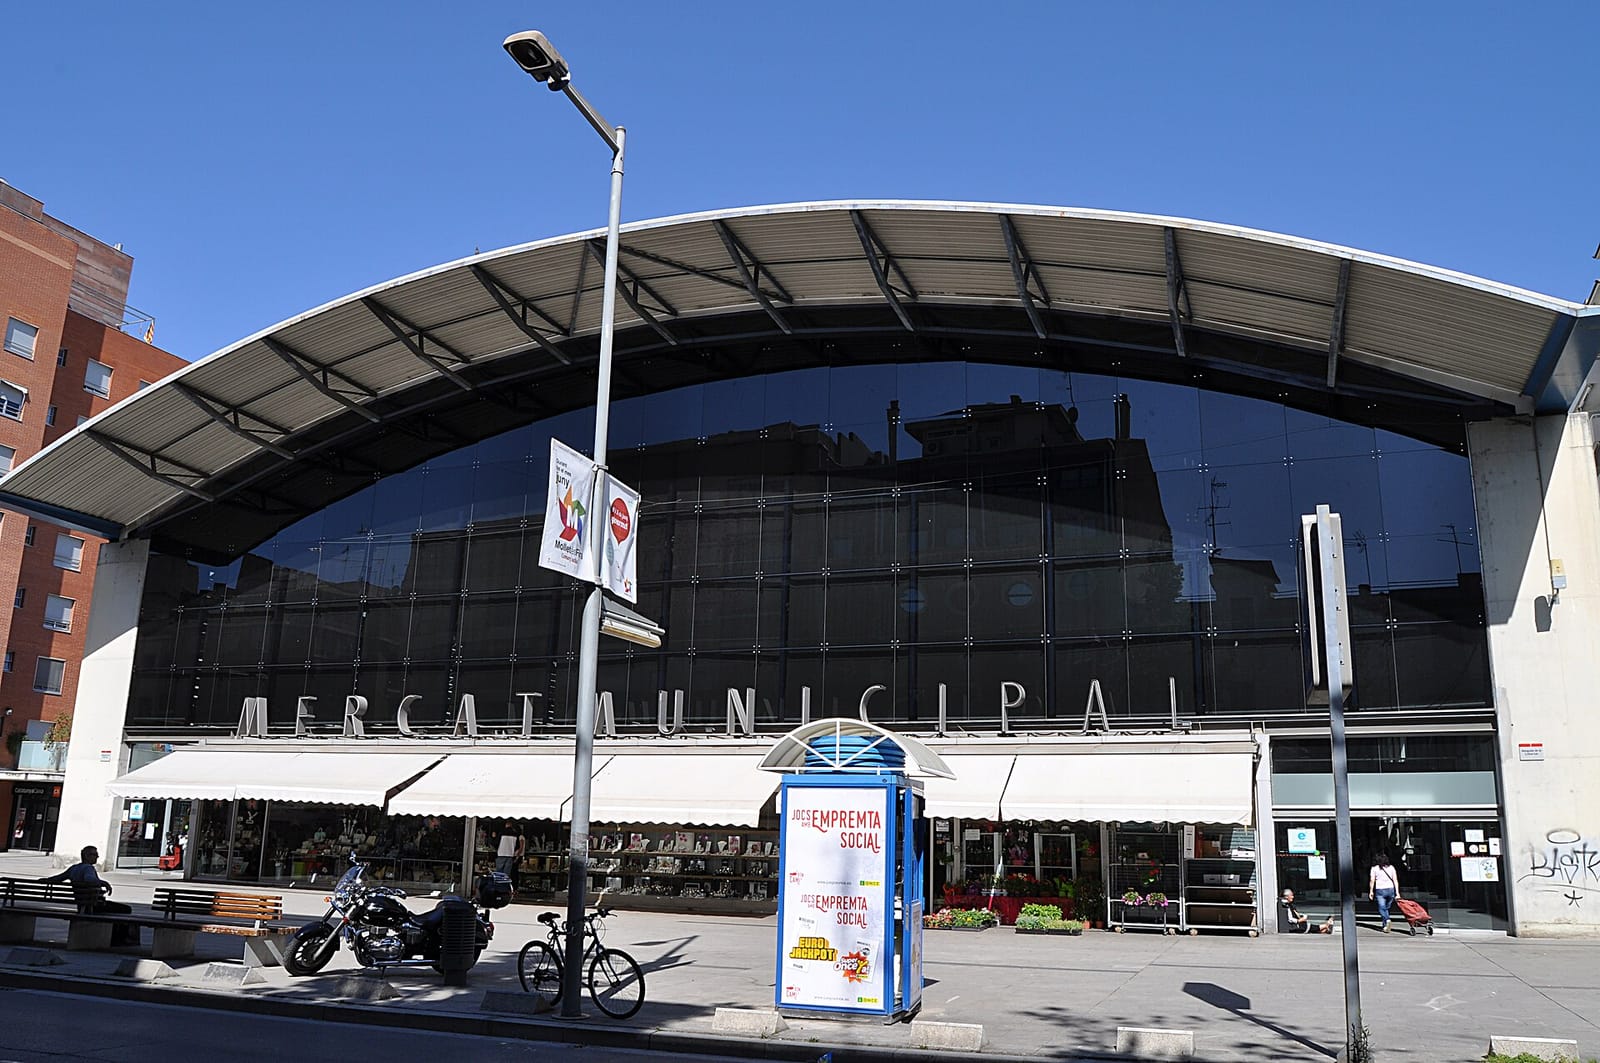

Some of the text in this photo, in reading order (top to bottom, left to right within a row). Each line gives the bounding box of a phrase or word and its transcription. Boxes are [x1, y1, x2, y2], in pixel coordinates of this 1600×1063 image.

[555, 471, 570, 489] juny
[236, 676, 1193, 739] MERCAT MUNICIPAL
[791, 809, 881, 833] JOCS EMPREMTA
[840, 831, 881, 854] SOCIAL
[800, 894, 868, 913] JOCS EMPREMTA
[837, 911, 868, 929] SOCIAL
[799, 937, 828, 949] EURO
[789, 947, 837, 961] JACKPOT
